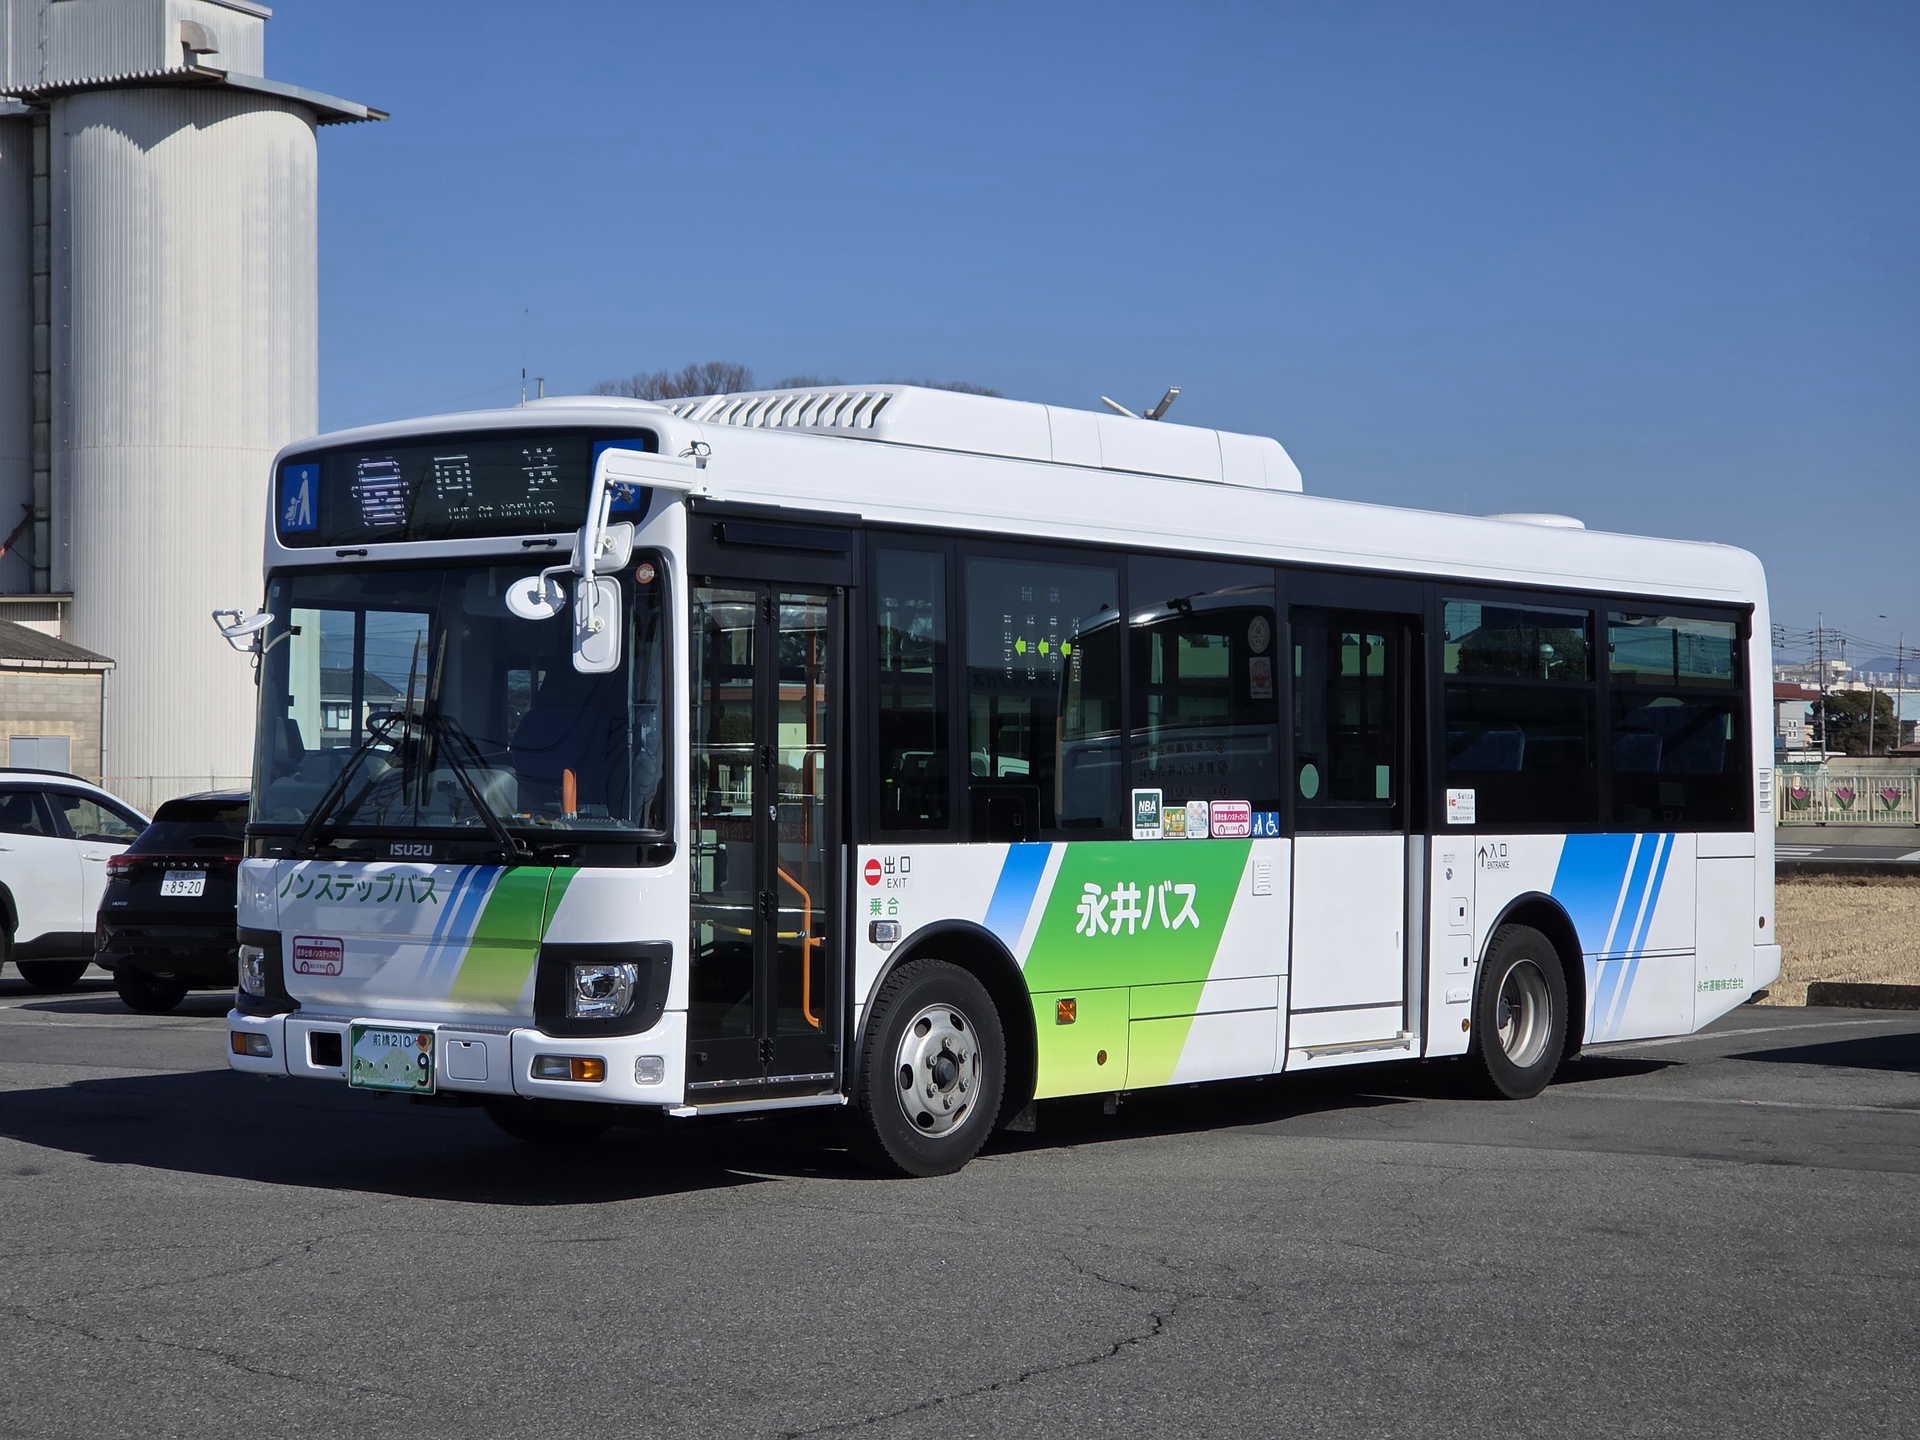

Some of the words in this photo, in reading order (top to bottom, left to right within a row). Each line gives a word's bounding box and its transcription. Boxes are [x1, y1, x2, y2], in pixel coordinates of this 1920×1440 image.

[1138, 800, 1157, 812] NBA
[390, 843, 433, 856] ISUZU
[1490, 843, 1507, 858] 入口
[884, 855, 911, 875] 出口
[1487, 861, 1510, 869] ENTRANCE
[279, 872, 438, 904] ノンステップバス
[887, 877, 908, 889] EXIT
[869, 896, 900, 916] 乗合
[1075, 878, 1201, 938] 永井バス
